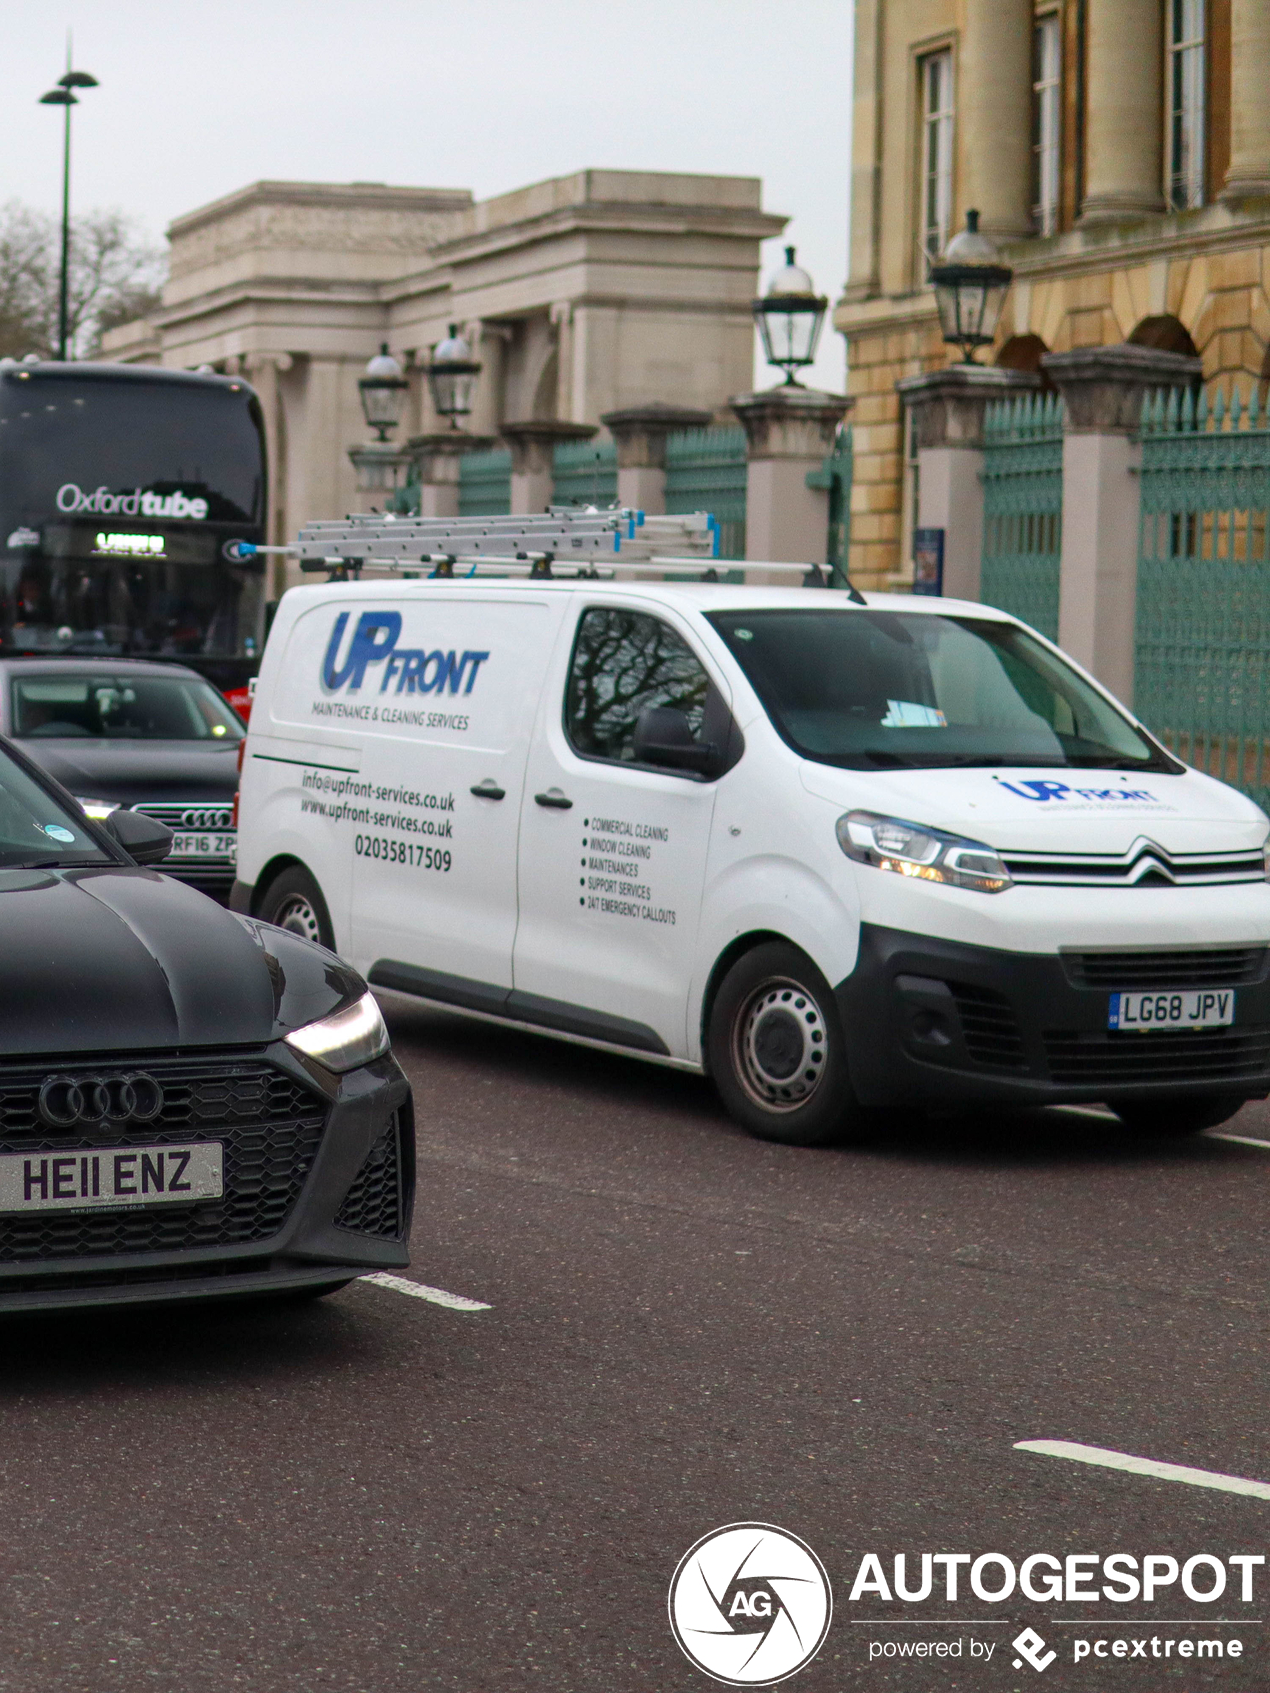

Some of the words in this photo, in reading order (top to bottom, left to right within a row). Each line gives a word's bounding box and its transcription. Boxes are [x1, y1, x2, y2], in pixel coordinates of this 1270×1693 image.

[312, 701, 371, 720] MAINTENANCE
[372, 707, 379, 721] &
[381, 707, 425, 726] CLEANING
[426, 712, 470, 731] SERVICES
[302, 770, 455, 812] info@upfront-services.co.uk
[301, 799, 453, 838] www.upfront-services.co.uk
[591, 817, 633, 836] COMMERCIAL
[635, 823, 669, 842] CLEANING
[174, 836, 209, 852] RF16
[355, 834, 452, 872] 02035817509
[590, 837, 617, 853] WINDOW
[618, 841, 651, 859] CLEANING
[589, 857, 638, 877] MAINTENANCES
[588, 876, 617, 893] SUPPORT
[619, 881, 651, 900] SERVICES
[601, 897, 641, 918] EMERGENCY
[642, 905, 676, 925] CALLOUTS
[1124, 995, 1182, 1022] LG68
[1188, 993, 1230, 1020] JPV
[114, 1151, 191, 1195] ENZ
